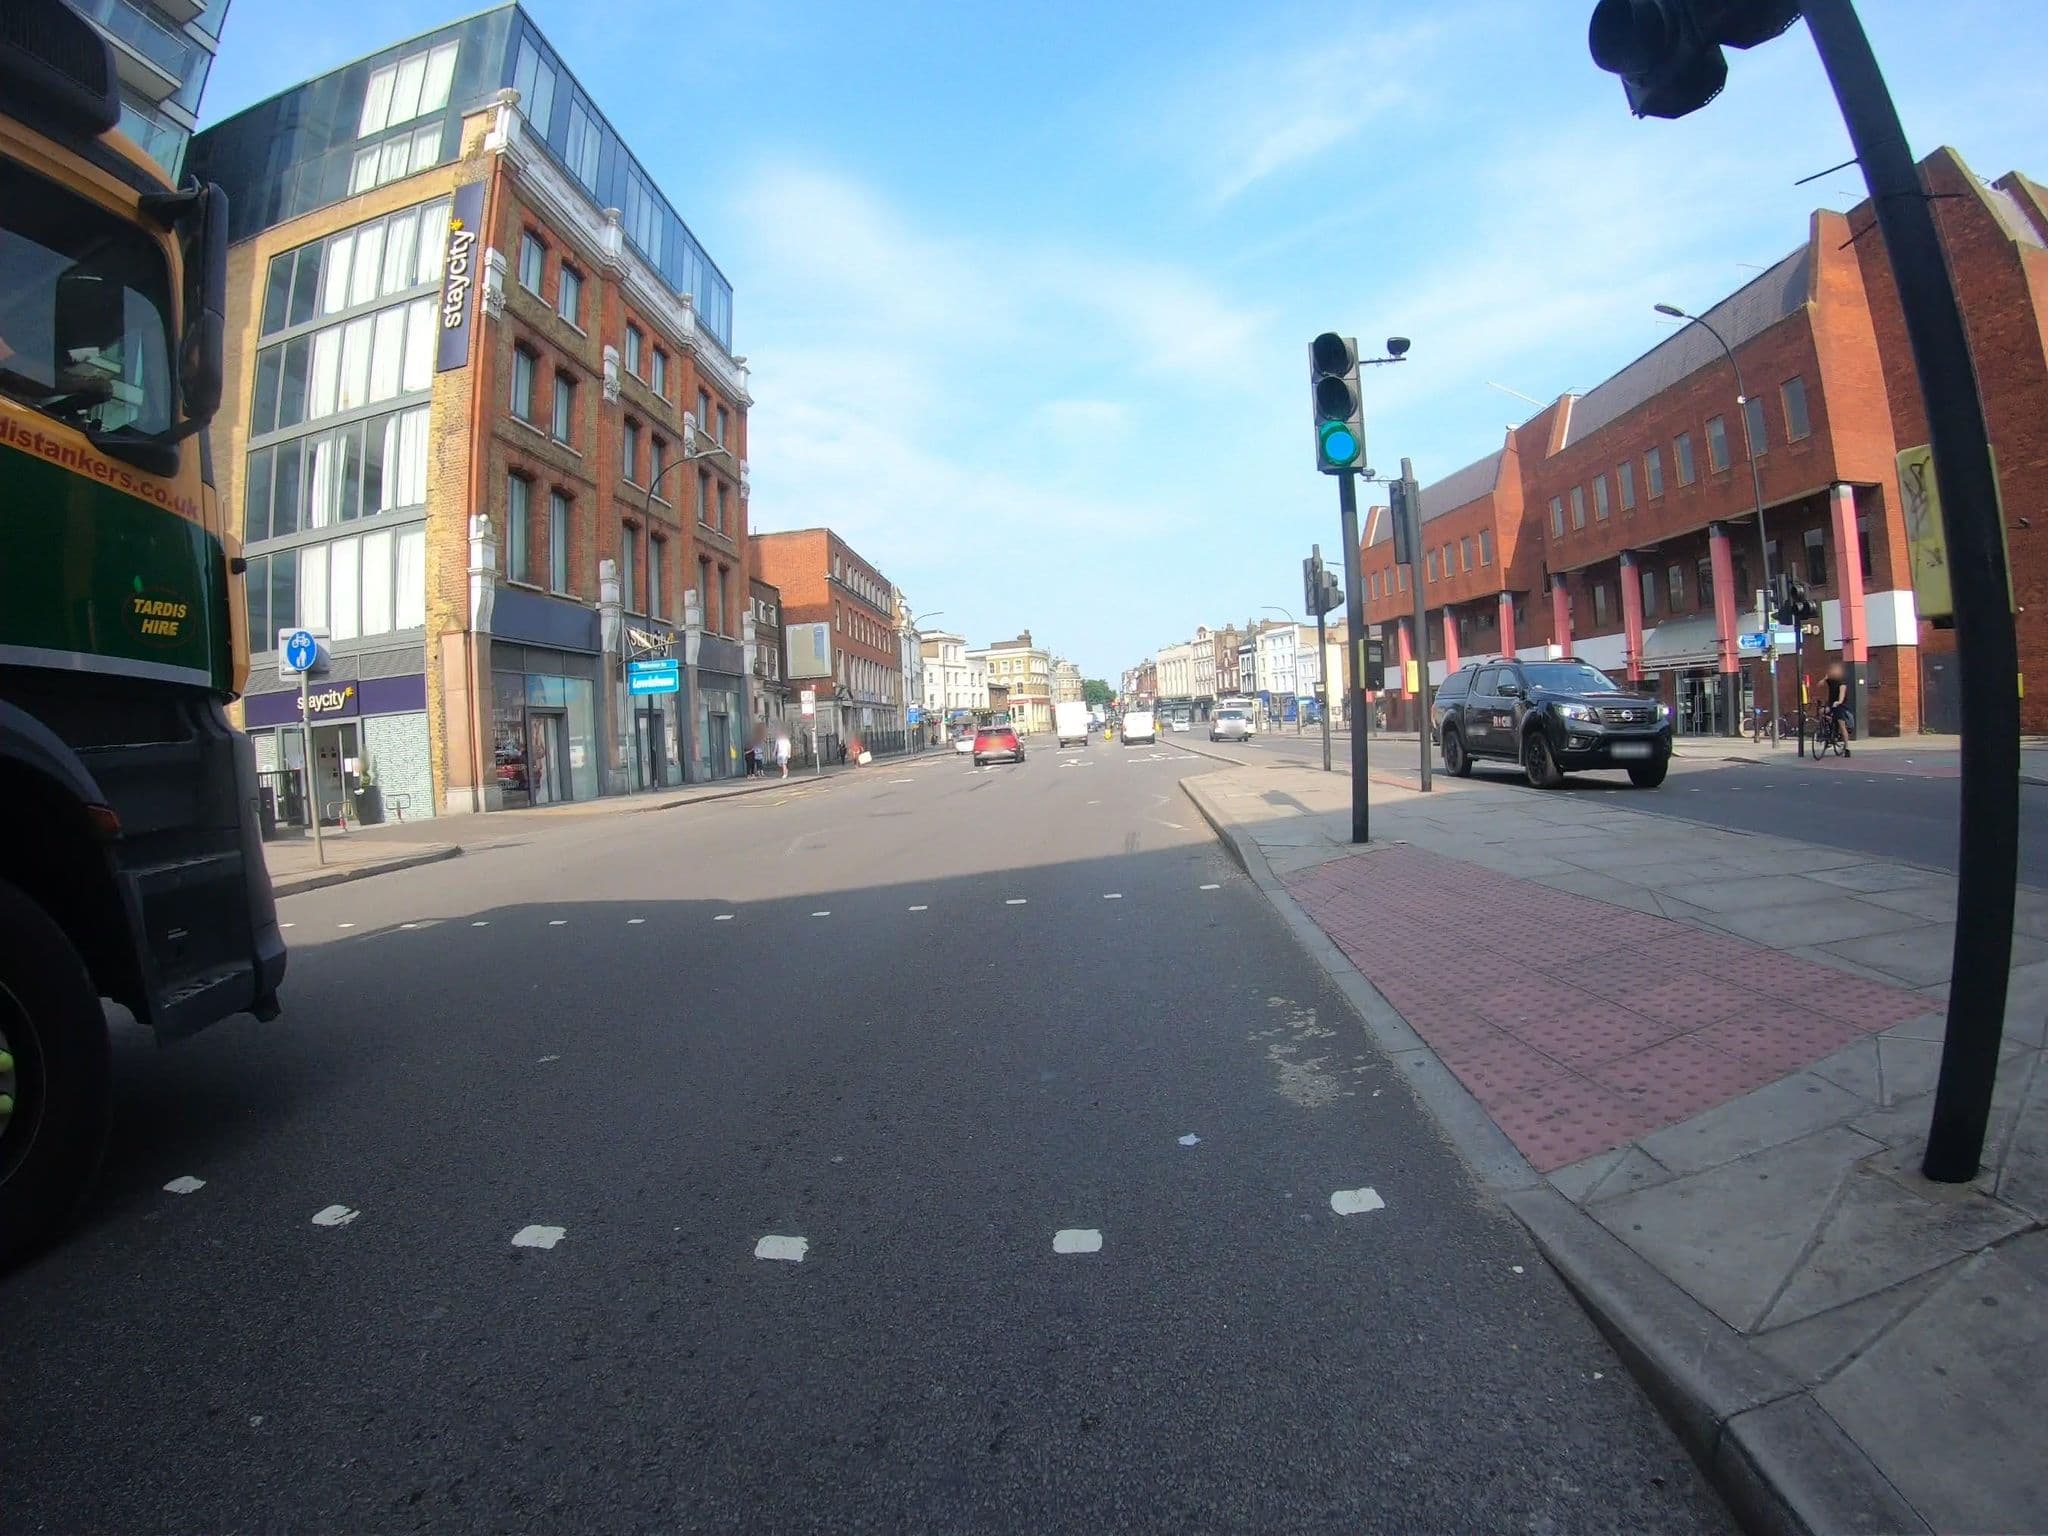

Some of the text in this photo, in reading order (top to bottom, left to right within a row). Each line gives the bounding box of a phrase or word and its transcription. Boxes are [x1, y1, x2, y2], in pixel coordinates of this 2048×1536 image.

[444, 230, 475, 328] staycity
[134, 598, 187, 618] TARDIS
[141, 619, 179, 636] HIRE
[296, 689, 346, 712] saycity
